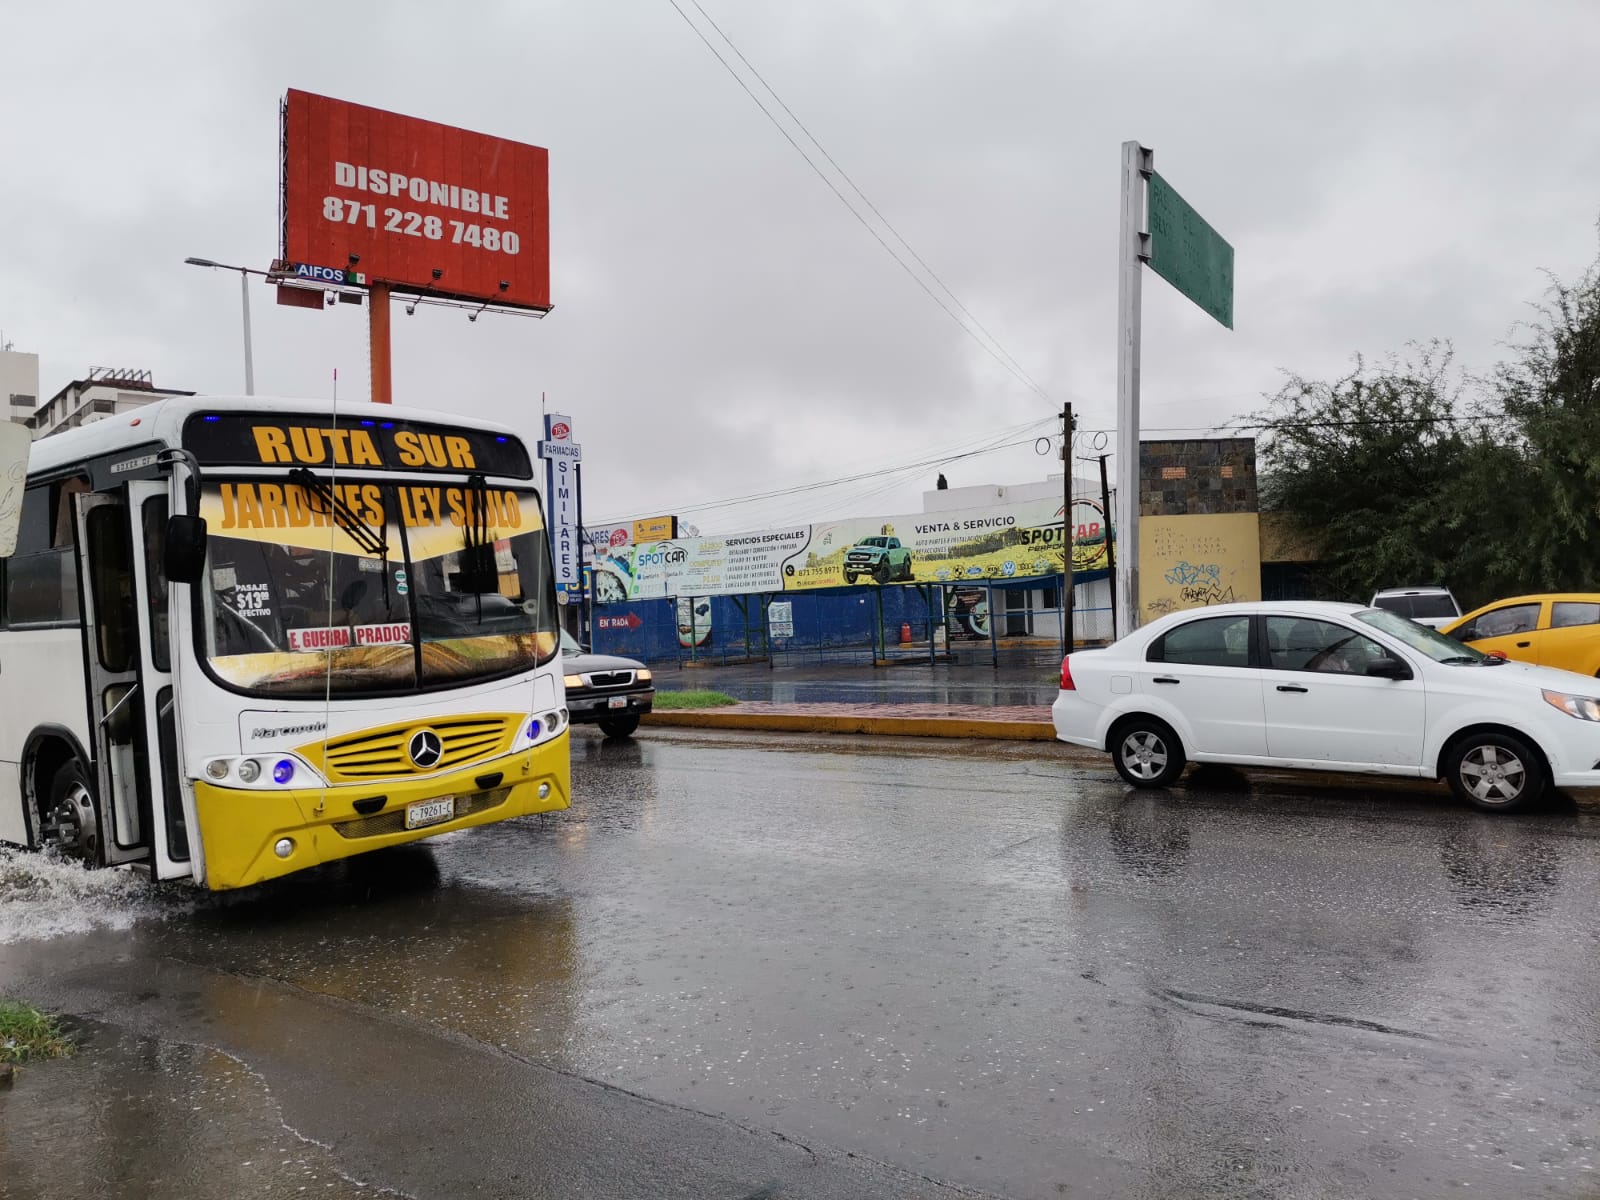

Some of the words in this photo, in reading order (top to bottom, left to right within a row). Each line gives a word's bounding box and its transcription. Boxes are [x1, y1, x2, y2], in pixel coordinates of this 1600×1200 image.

[335, 161, 509, 220] DISPONIBLE
[323, 197, 376, 229] 871
[384, 207, 443, 240] 228
[449, 220, 520, 255] 7480
[298, 264, 344, 281] AIFOS
[252, 426, 382, 466] RUTA
[394, 431, 476, 469] SUR
[545, 444, 579, 457] FARMACIAS
[397, 486, 441, 527] LEY
[558, 461, 571, 578] SIMILARES
[915, 523, 950, 534] VENTA
[953, 521, 960, 531] &
[963, 516, 1015, 530] SERVICIO
[588, 530, 609, 544] ARES
[725, 537, 761, 546] SERVICIOS
[762, 531, 805, 543] ESPECIALES
[1020, 522, 1100, 545] SPOTAR
[236, 583, 269, 592] PASAJE
[239, 607, 271, 617] EFECTIVO
[290, 631, 300, 649] E.
[302, 629, 350, 648] GUERRA
[356, 625, 410, 645] PRADOS
[252, 721, 327, 739] Marcopolo
[409, 801, 453, 821] C-79261-C
